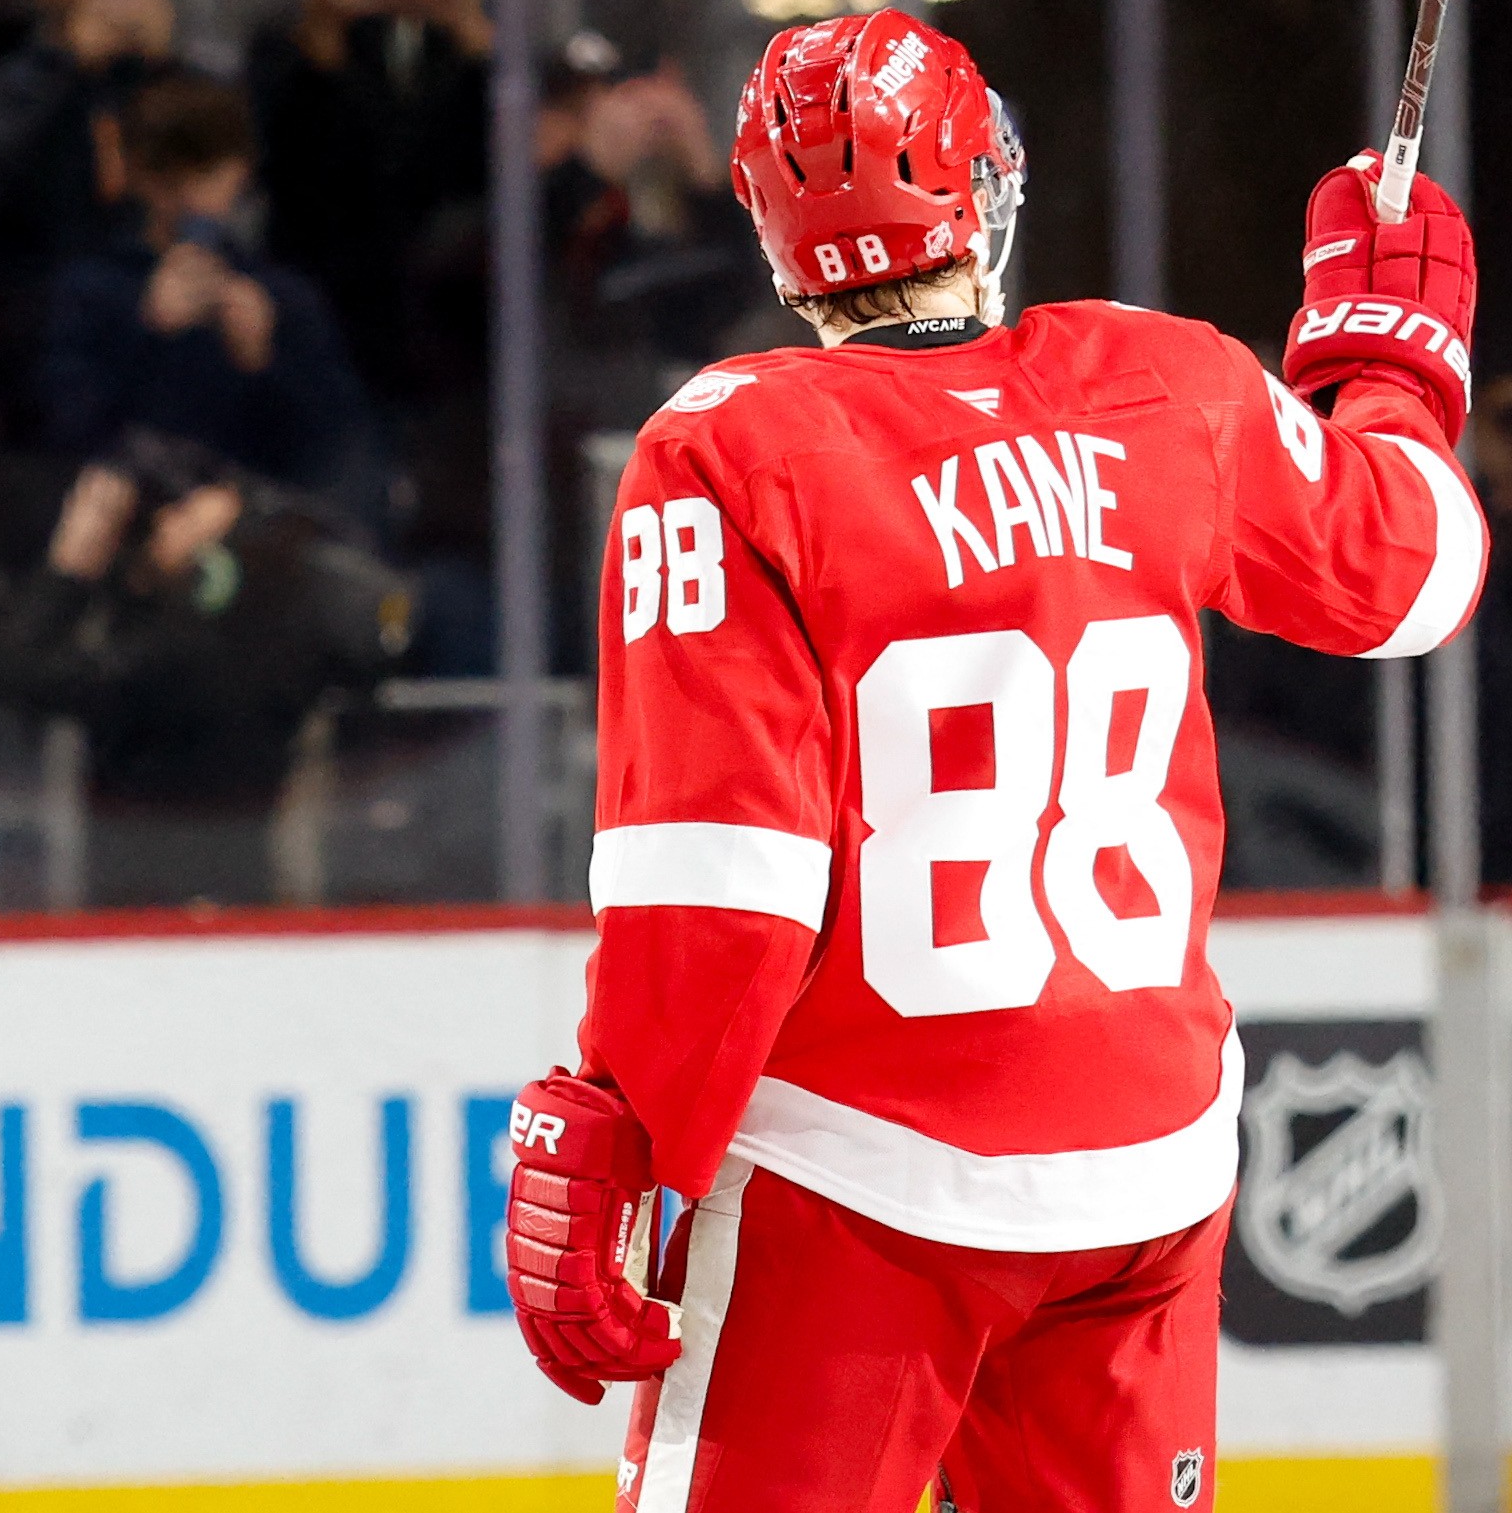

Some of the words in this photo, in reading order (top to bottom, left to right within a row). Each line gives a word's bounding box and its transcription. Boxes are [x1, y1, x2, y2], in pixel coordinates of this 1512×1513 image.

[871, 30, 932, 98] meijer
[813, 233, 890, 283] 88
[621, 495, 726, 645] 88
[911, 429, 1134, 589] KANE
[858, 613, 1194, 1017] 88
